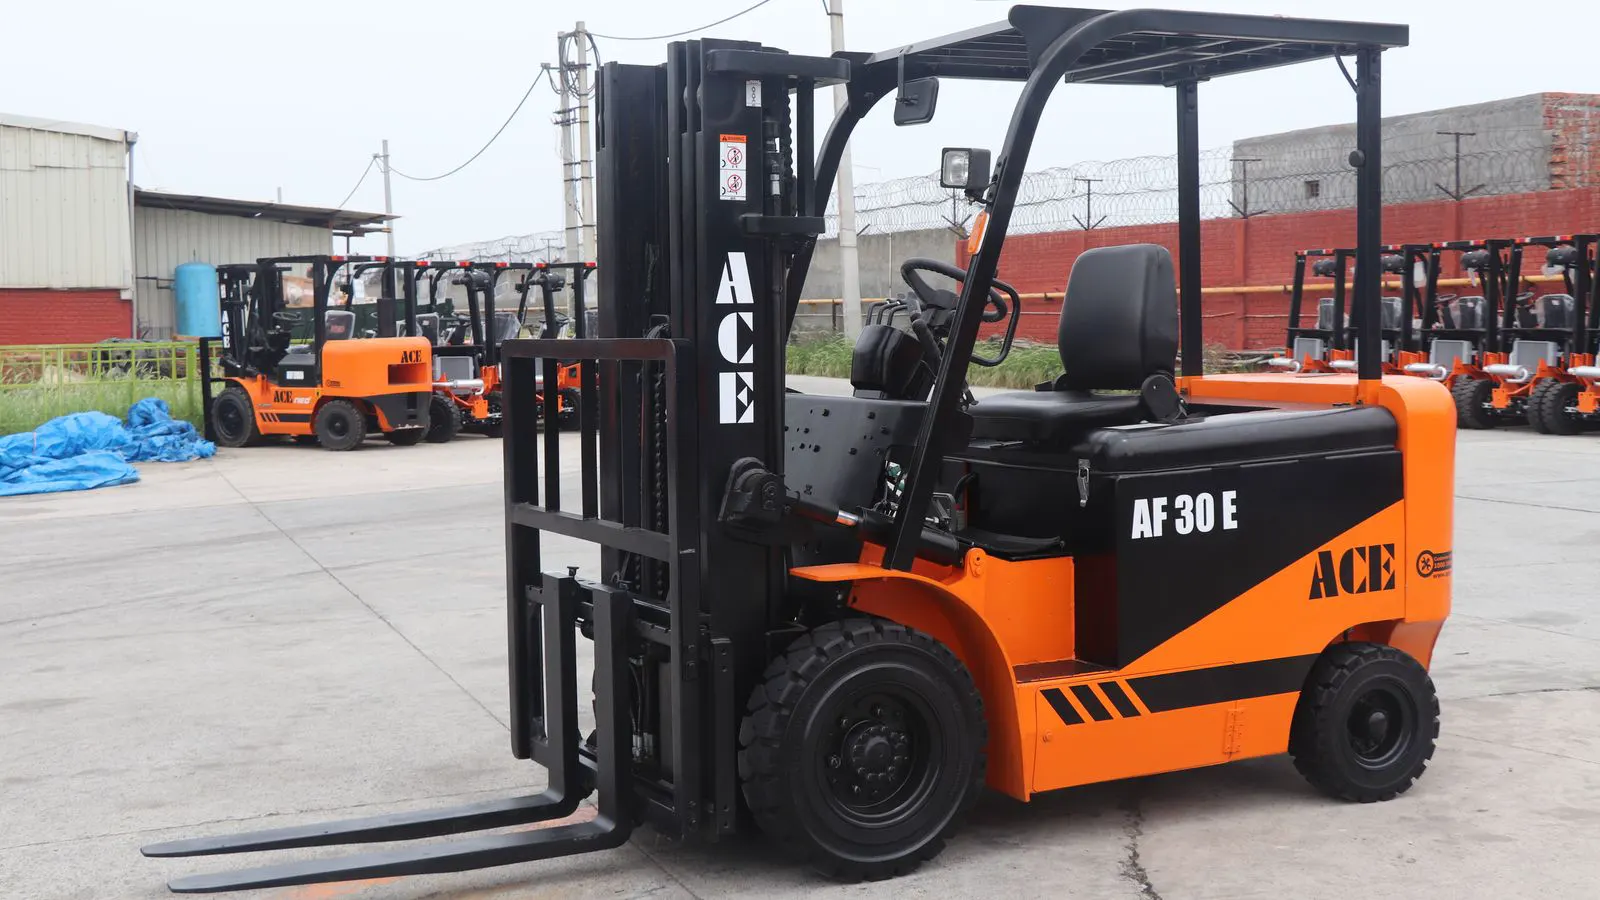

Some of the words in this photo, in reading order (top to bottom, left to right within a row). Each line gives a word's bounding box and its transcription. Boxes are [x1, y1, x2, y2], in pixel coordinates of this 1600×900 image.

[400, 350, 422, 364] ACE
[715, 251, 755, 424] ACE
[273, 390, 293, 403] ACE
[1131, 496, 1168, 539] AF
[1174, 492, 1215, 535] 30
[1222, 490, 1238, 530] E
[1308, 543, 1396, 600] ACE
